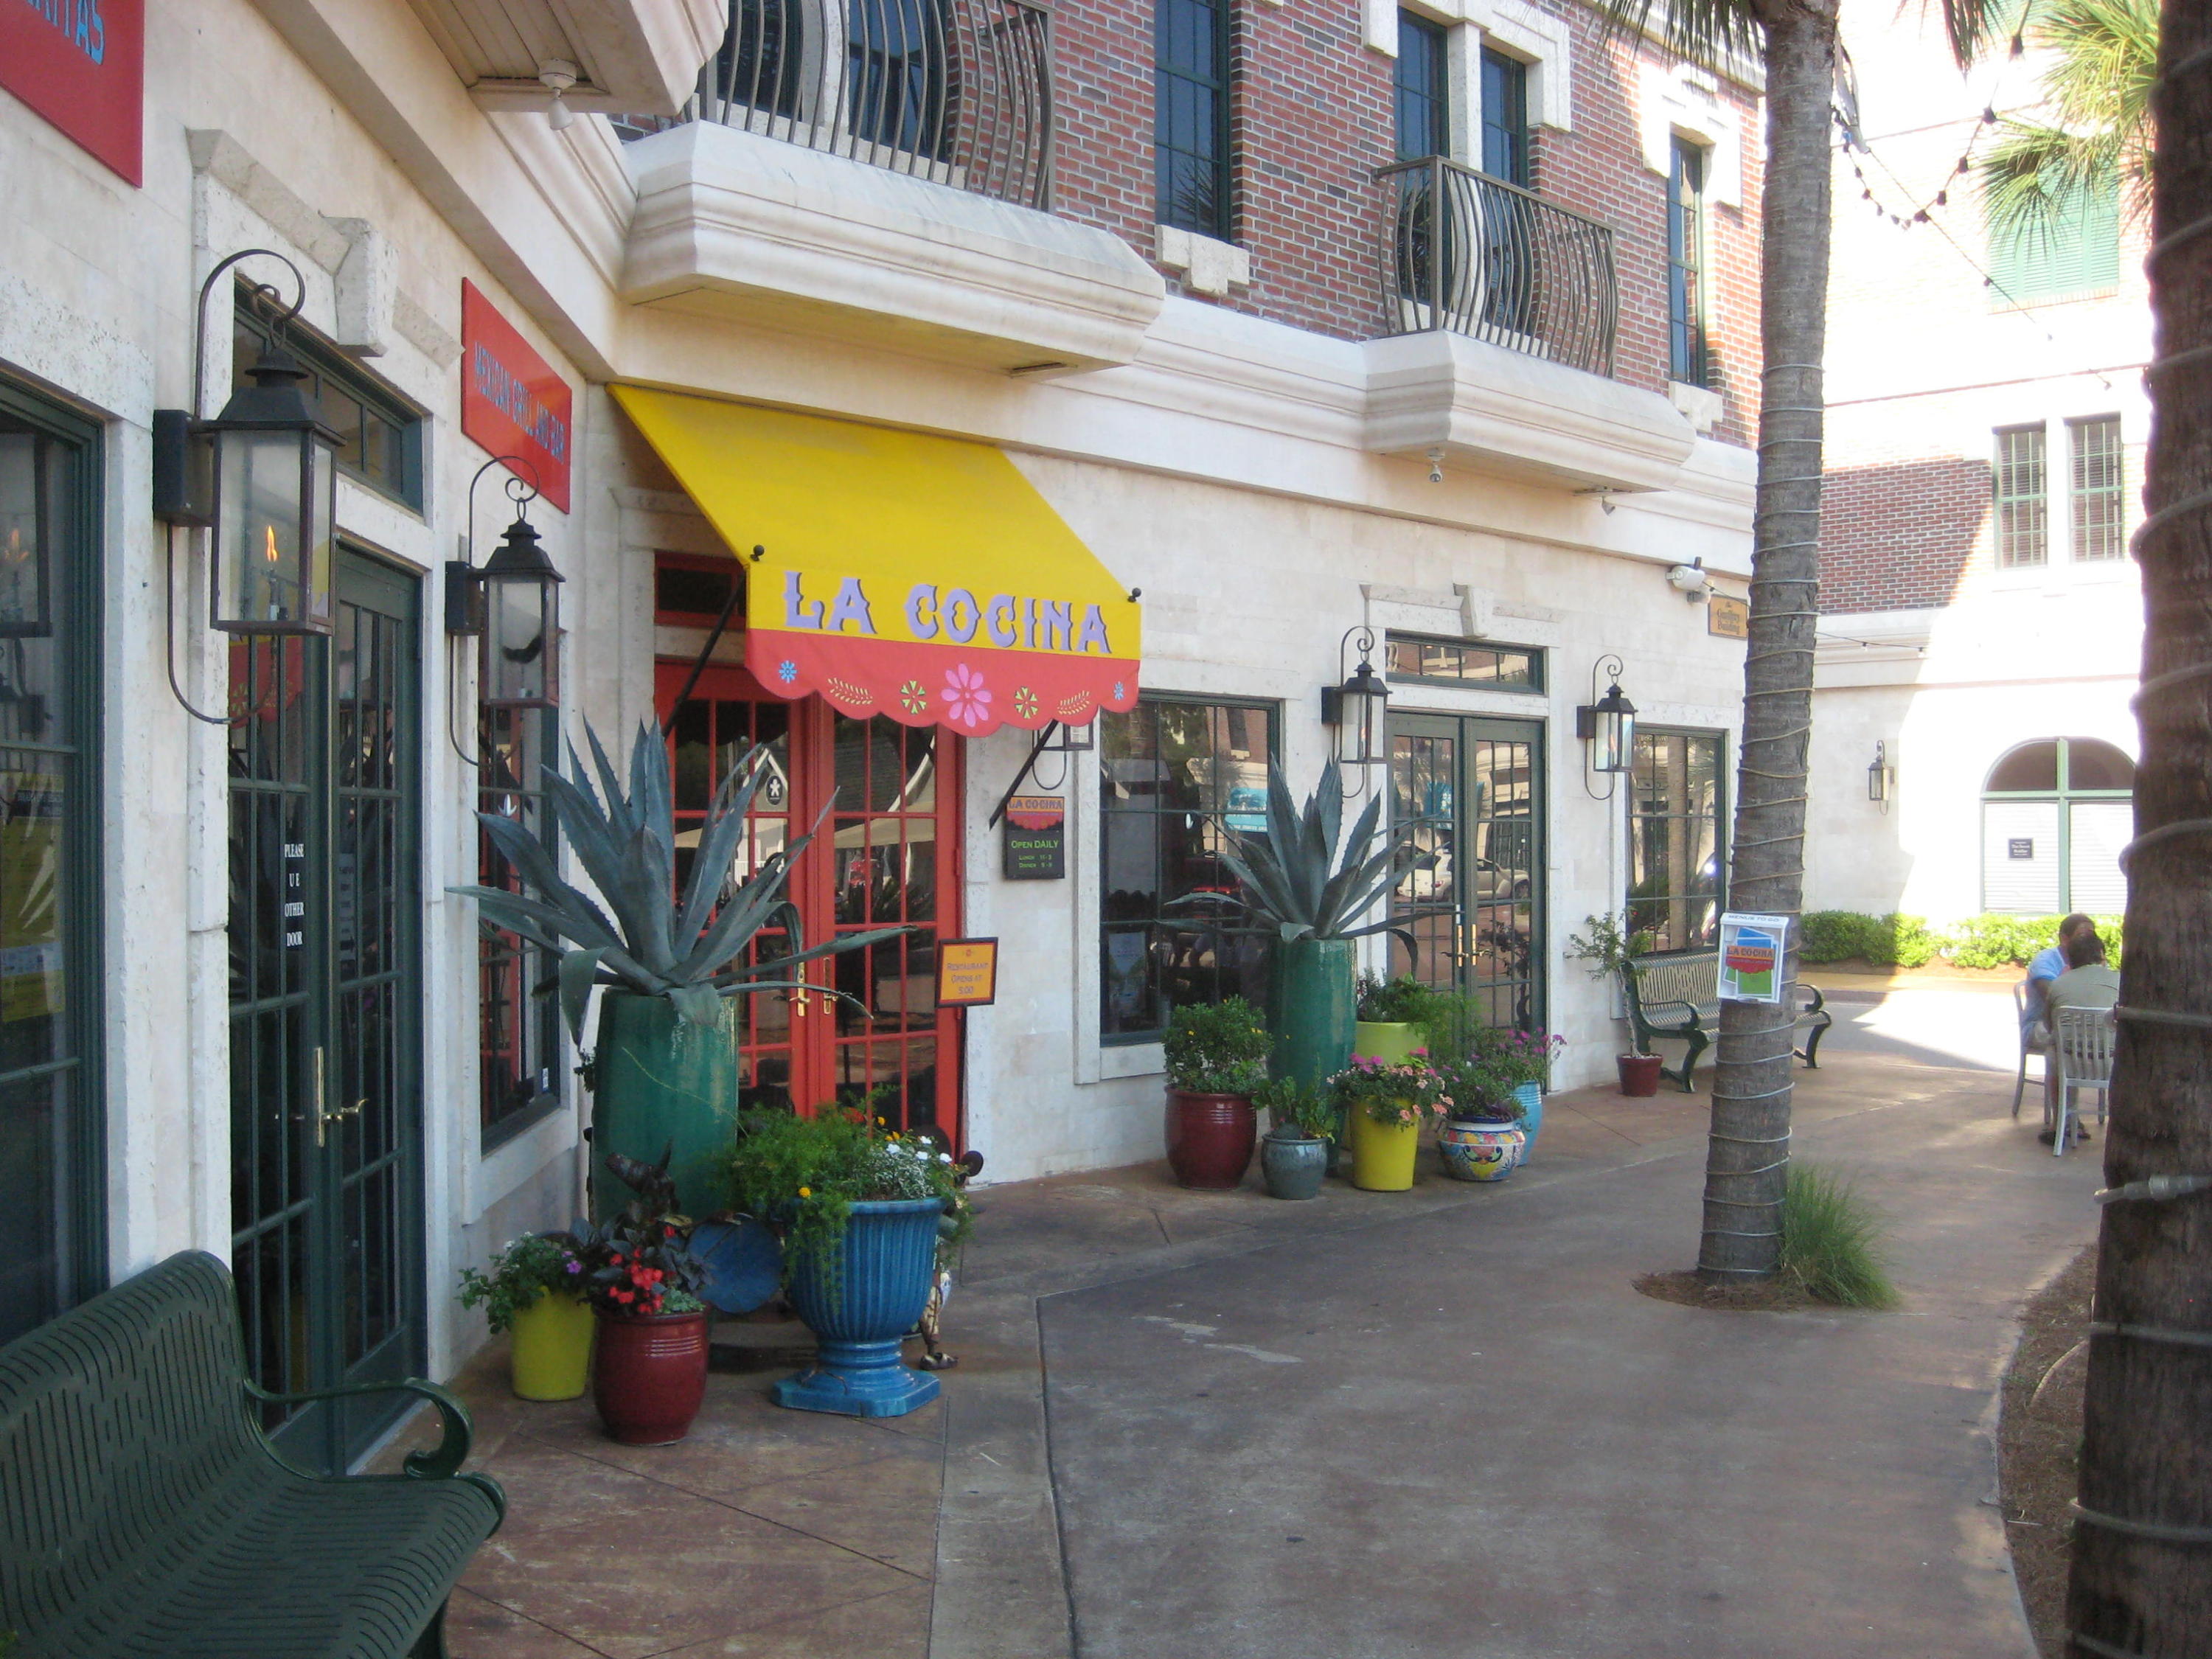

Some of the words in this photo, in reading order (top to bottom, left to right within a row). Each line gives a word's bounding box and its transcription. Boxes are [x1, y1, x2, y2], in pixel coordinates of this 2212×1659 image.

[782, 571, 877, 634] LA
[903, 583, 1113, 654] COCINA
[285, 844, 305, 858] PLEASE
[285, 902, 305, 917] OTHER
[286, 931, 302, 947] DOOR
